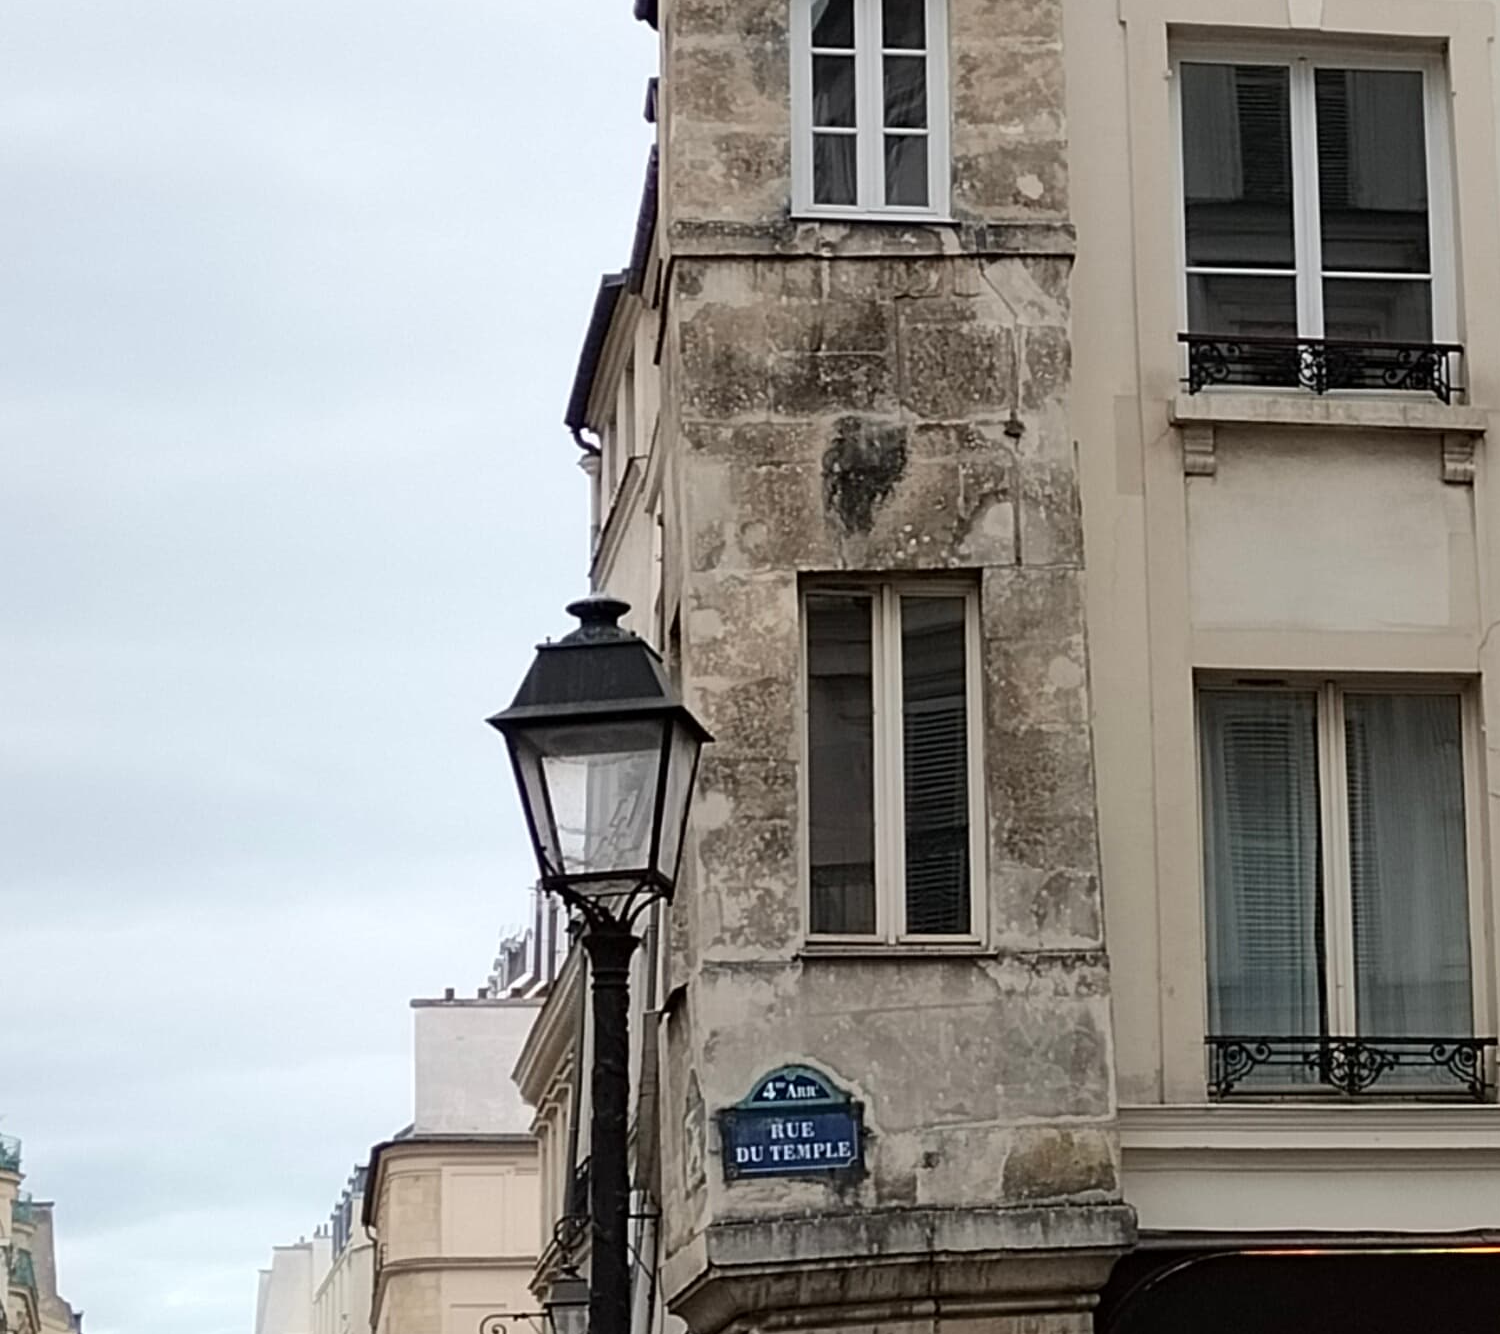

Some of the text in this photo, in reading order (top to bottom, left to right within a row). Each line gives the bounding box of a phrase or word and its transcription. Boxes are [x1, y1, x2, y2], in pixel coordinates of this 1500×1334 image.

[771, 1122, 815, 1139] RUE
[736, 1141, 851, 1163] DU TEMPLE
